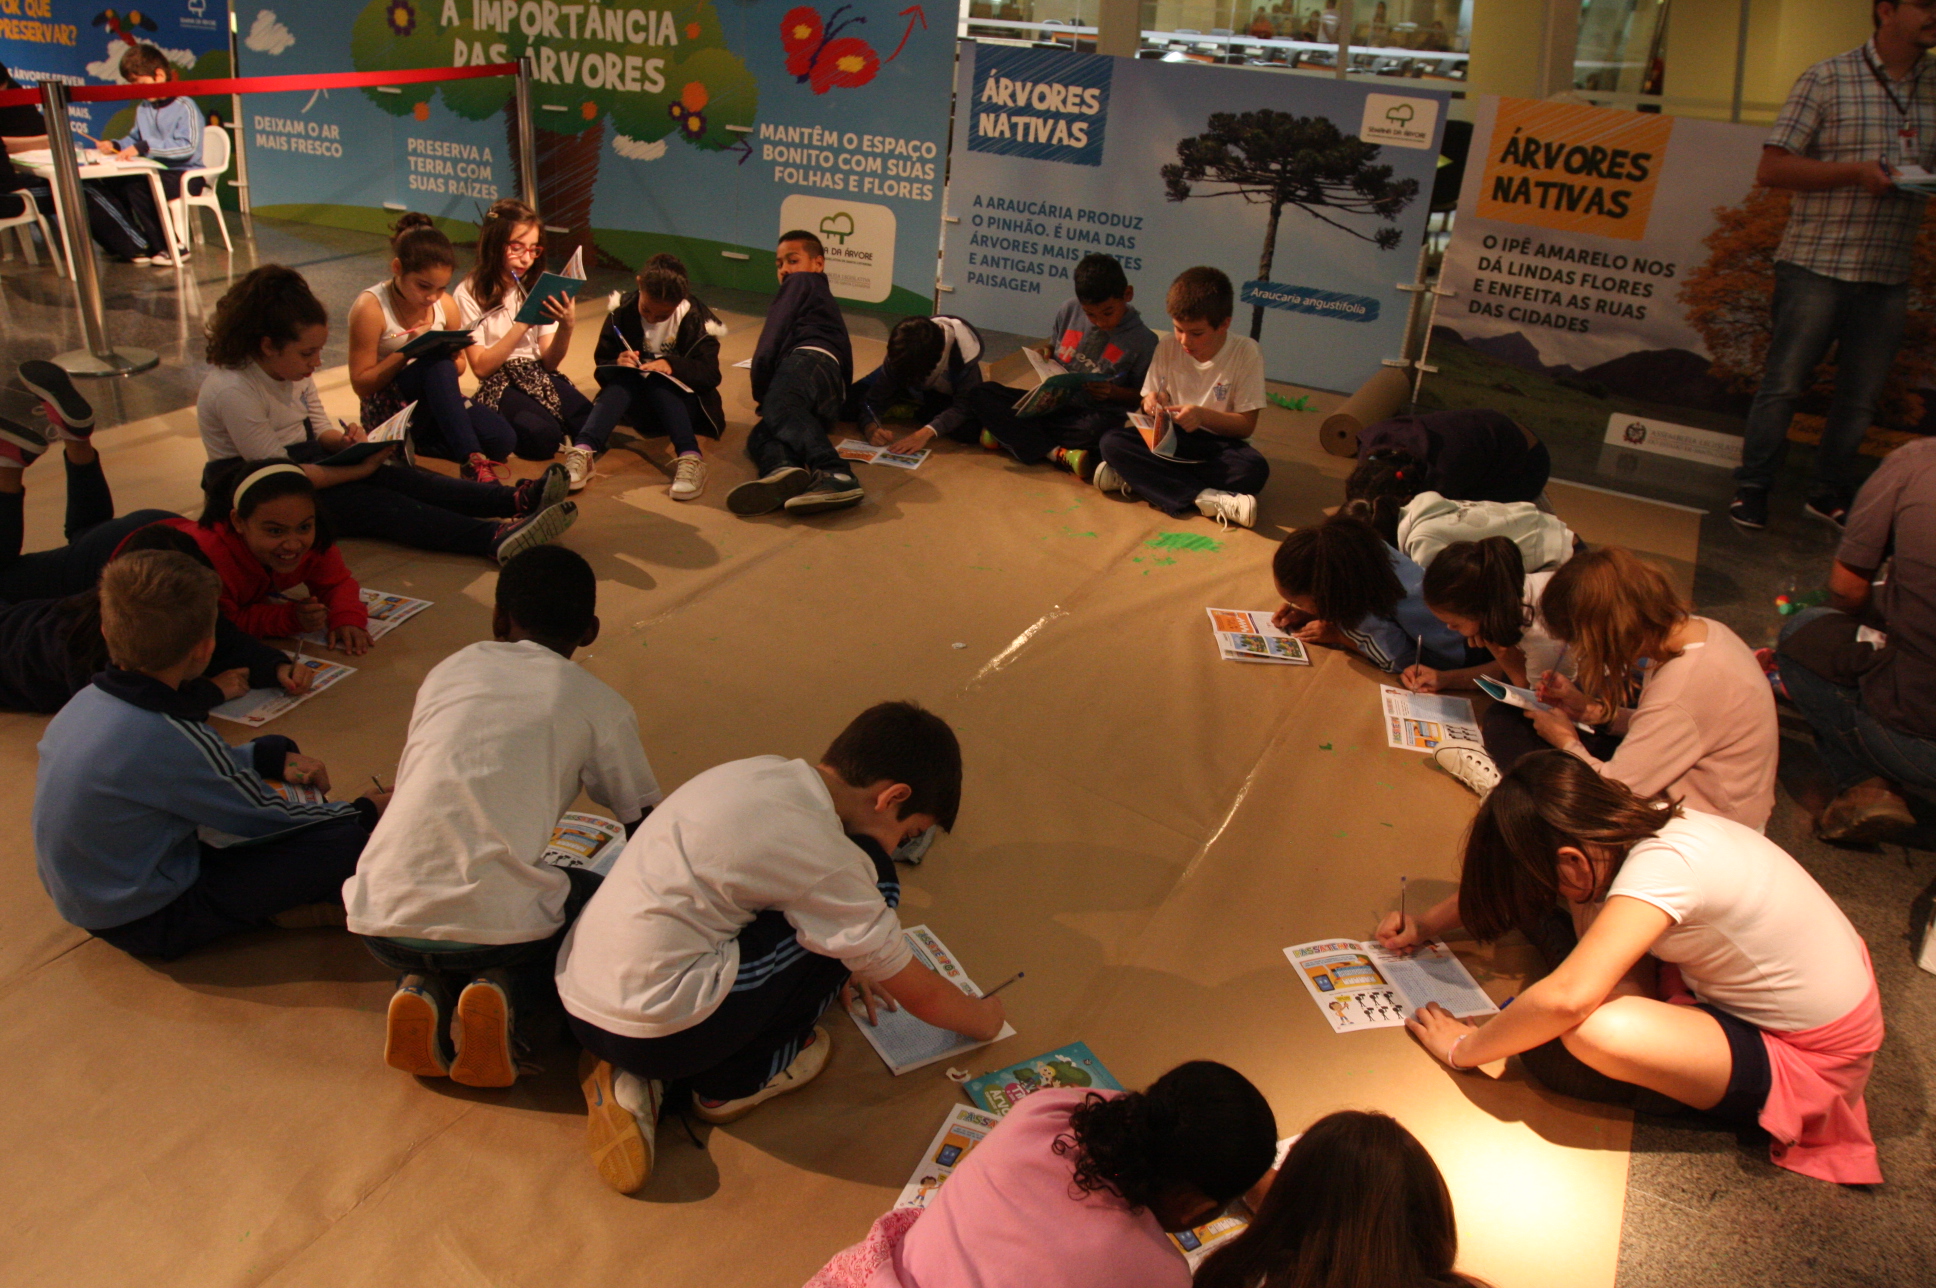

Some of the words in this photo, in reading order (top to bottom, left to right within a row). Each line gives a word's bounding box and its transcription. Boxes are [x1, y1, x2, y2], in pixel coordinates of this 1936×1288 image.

[0, 0, 22, 15] OR
[24, 0, 52, 18] QUE
[440, 0, 460, 27] A
[473, 0, 679, 46] IMPORTÂNCIA
[453, 38, 507, 77] DAS
[524, 35, 666, 93] ÁRVORES
[981, 68, 1101, 116] ÁRVORES
[254, 115, 305, 136] DEIXAM
[307, 122, 319, 137] O
[321, 123, 340, 140] AR
[256, 133, 288, 151] MAIS
[291, 138, 343, 158] FRESCO
[760, 123, 838, 148] MANTÊM
[843, 133, 858, 149] O
[863, 135, 937, 161] ESPAÇO
[978, 112, 1089, 149] NATIVAS
[408, 137, 479, 162] PRESERVA
[482, 147, 493, 162] A
[763, 144, 834, 168] BONITO
[838, 153, 882, 174] COM
[887, 158, 935, 180] SUAS
[1500, 127, 1652, 182] ÁRVORES
[408, 156, 454, 176] TERRA
[456, 163, 492, 181] COM
[774, 166, 844, 190] FOLHAS
[849, 175, 859, 192] E
[864, 177, 933, 201] FLORES
[409, 174, 445, 193] SUAS
[448, 179, 498, 200] RAÍZES
[1492, 175, 1632, 219] NATIVAS
[973, 194, 983, 208] A
[986, 195, 1073, 221] ARAUCÁRIA
[1077, 208, 1144, 231] PRODUZ
[972, 214, 984, 227] O
[987, 216, 1049, 238] PINHÃO.
[1054, 223, 1063, 239] É
[1066, 227, 1101, 245] UMA
[1105, 232, 1136, 250] DAS
[831, 247, 842, 257] DA
[844, 247, 873, 260] ÁRVORE
[969, 231, 1038, 255] ÁRVORES
[1042, 244, 1079, 262] MAIS
[1084, 250, 1142, 271] TES
[969, 252, 977, 265] E
[980, 254, 1044, 275] ANTIGAS
[1048, 264, 1069, 280] DA
[1483, 235, 1497, 249] O
[1502, 237, 1531, 255] IPÊ
[1534, 243, 1628, 270] AMARELO
[1632, 258, 1676, 278] NOS
[967, 271, 1041, 294] PAISAGEM
[1477, 255, 1503, 274] DÁ
[1507, 261, 1576, 285] LINDAS
[1580, 273, 1653, 298] FLORES
[1251, 287, 1301, 304] Araucaria
[1303, 294, 1366, 315] angustifolia
[1468, 300, 1505, 319] DAS
[1508, 307, 1589, 333] CIDADES
[1473, 279, 1484, 293] E
[1488, 280, 1562, 307] ENFEITA
[1566, 293, 1590, 311] AS
[1595, 299, 1647, 321] RUAS
[1292, 942, 1363, 959] PASSATEMPOS
